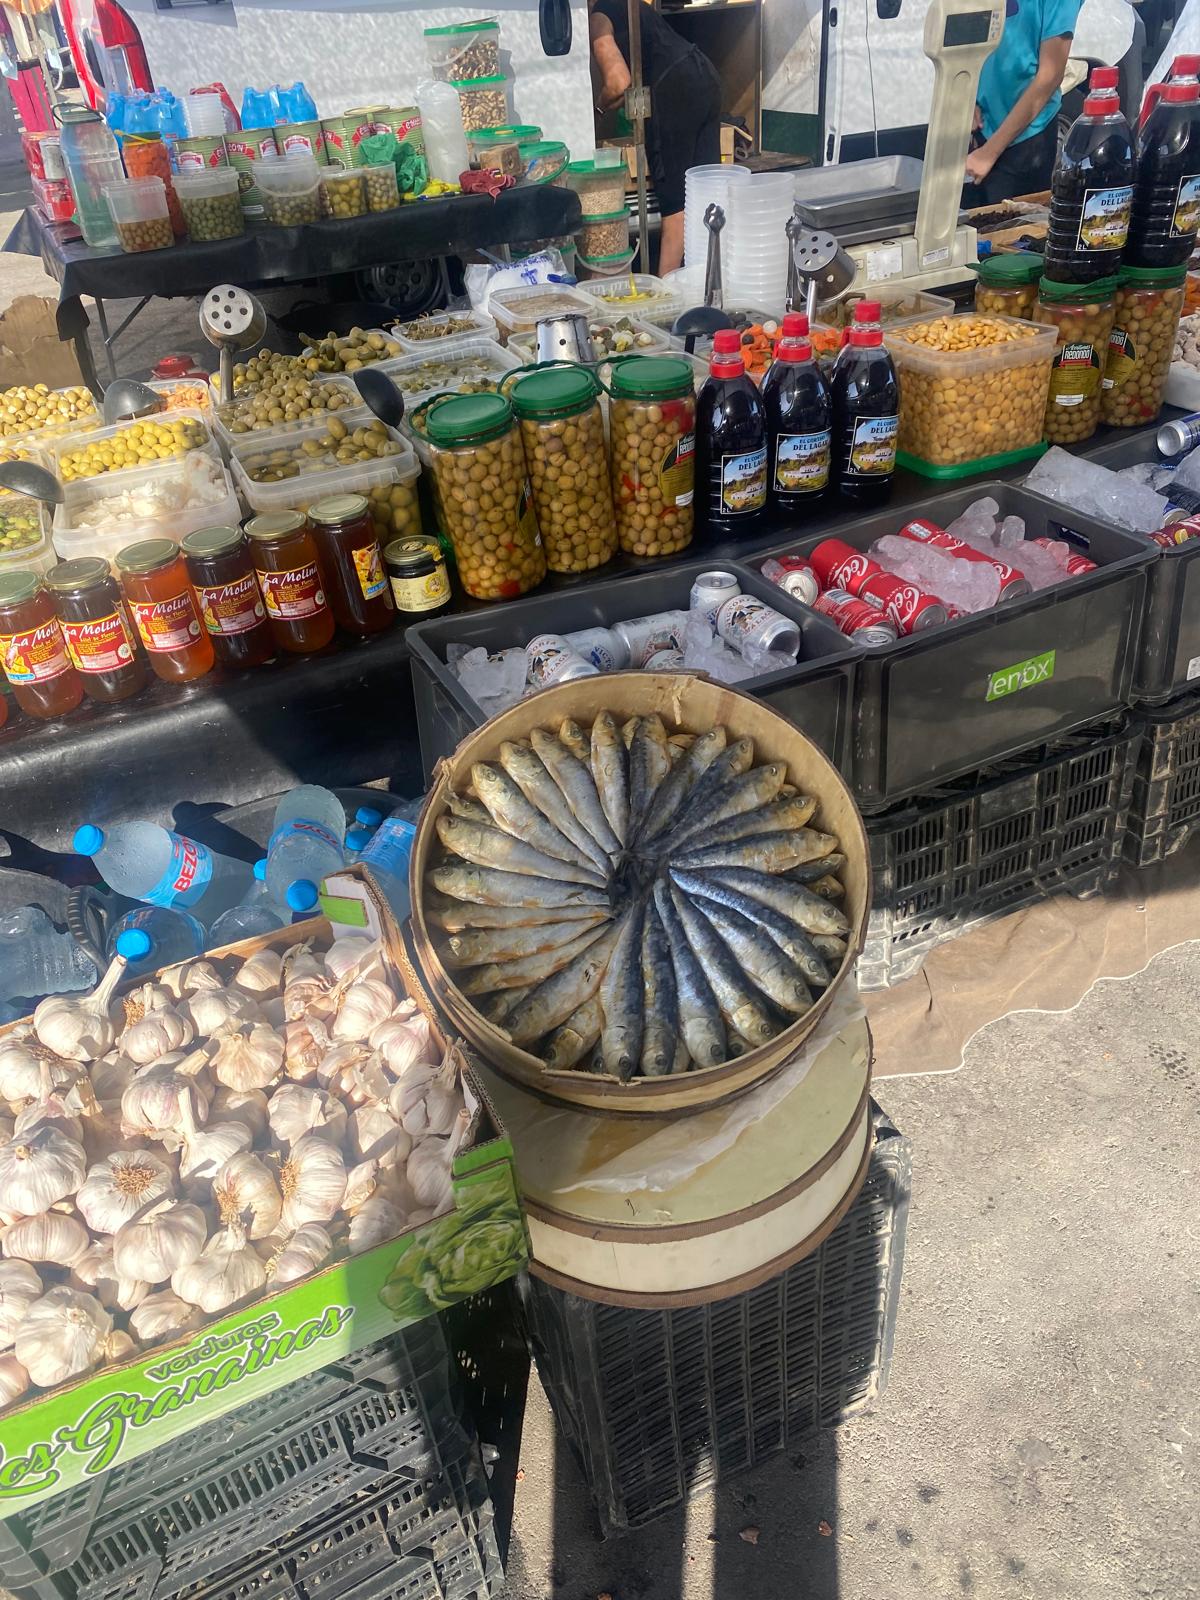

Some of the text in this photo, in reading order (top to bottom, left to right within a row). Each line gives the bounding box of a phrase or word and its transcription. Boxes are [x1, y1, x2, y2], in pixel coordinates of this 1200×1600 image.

[739, 462, 753, 470] DEL
[264, 572, 279, 585] La
[202, 588, 217, 600] La
[135, 604, 149, 617] La
[10, 634, 29, 649] La
[31, 621, 58, 648] Moli
[64, 617, 121, 639] La Molina
[145, 1312, 280, 1381] verduras
[56, 1304, 355, 1475] Granainos
